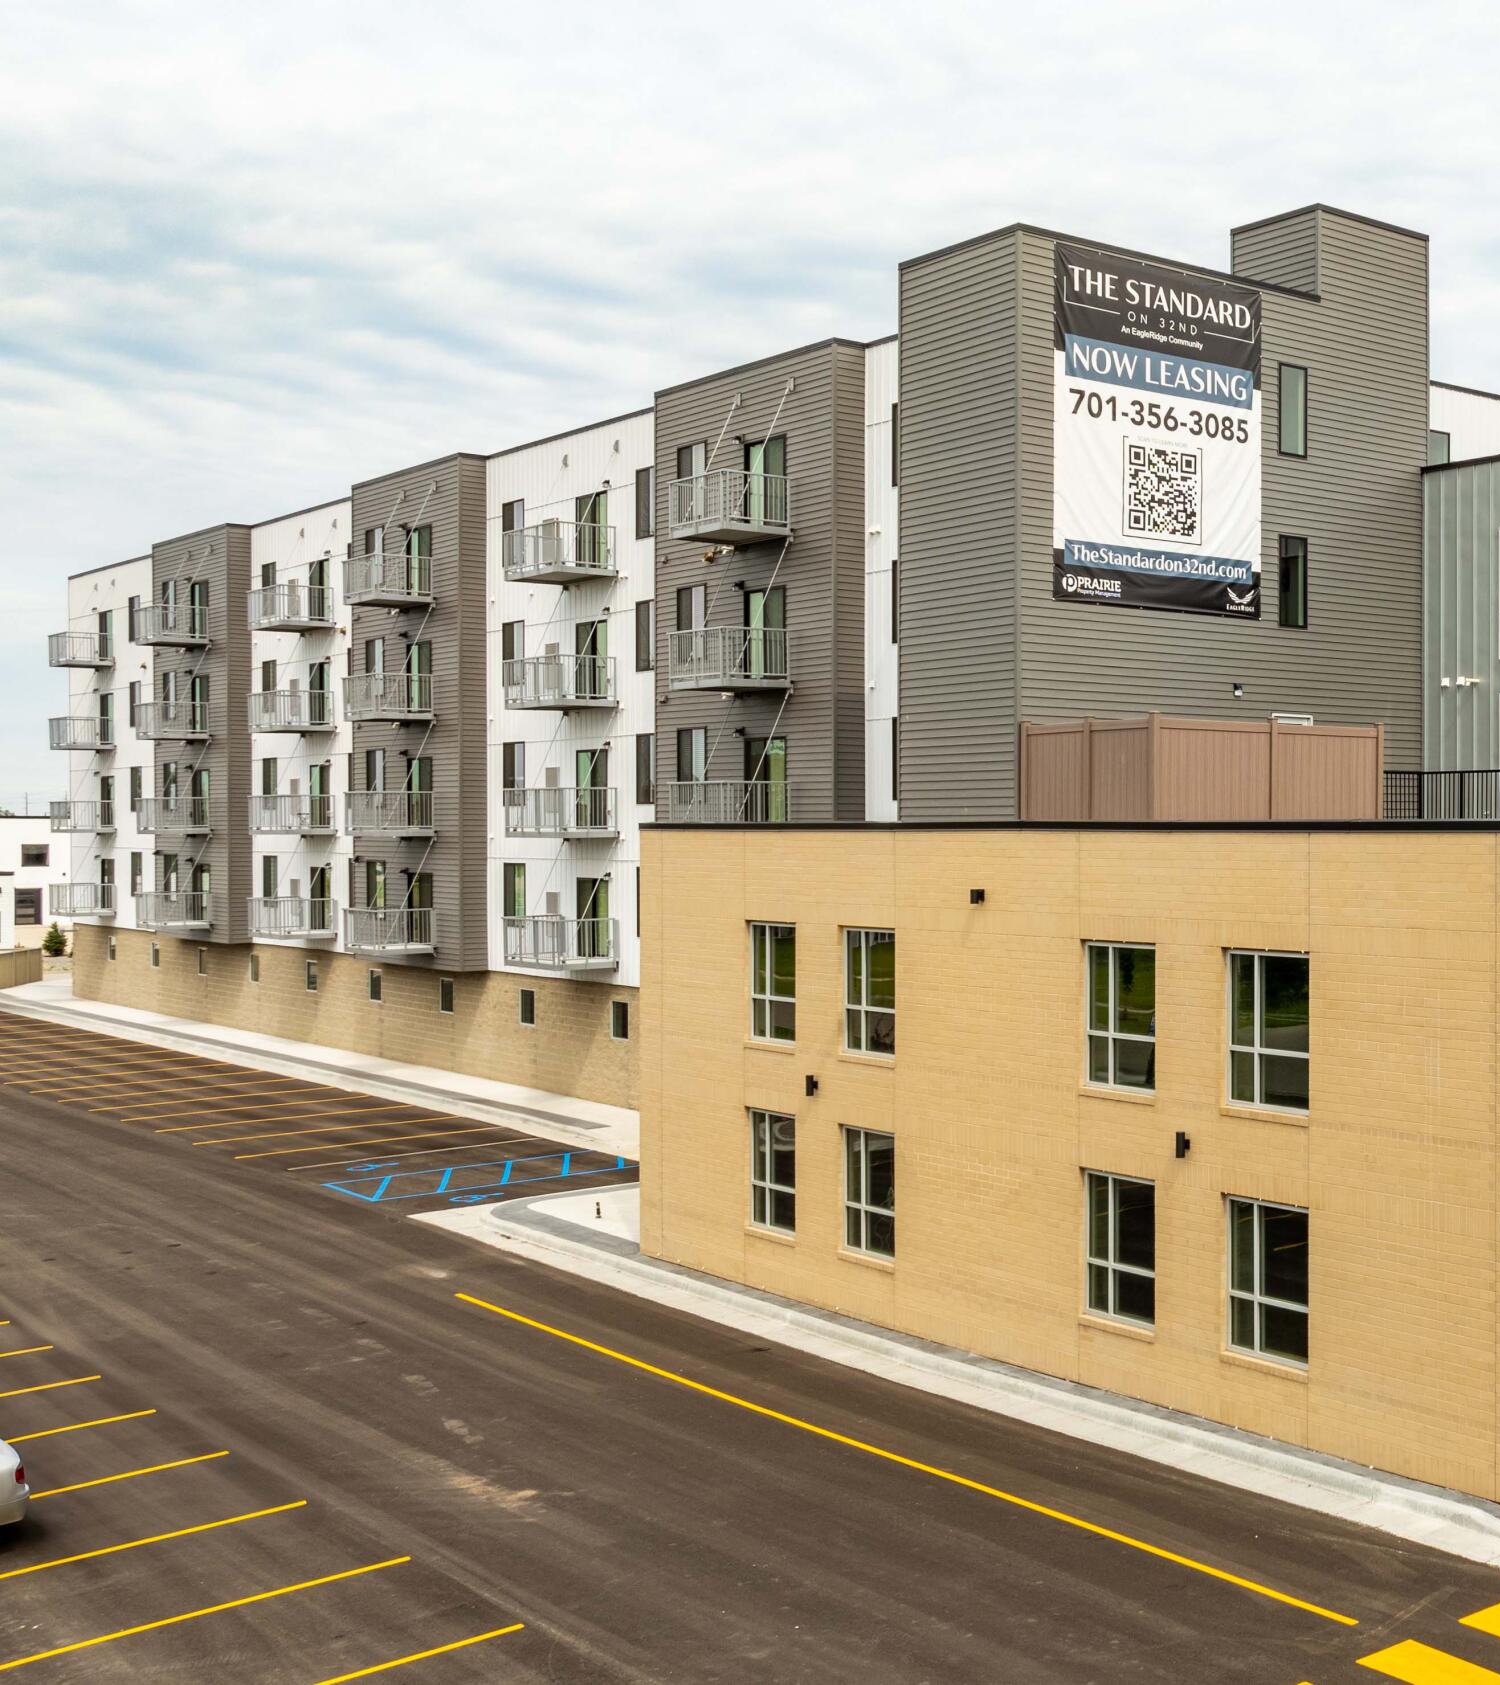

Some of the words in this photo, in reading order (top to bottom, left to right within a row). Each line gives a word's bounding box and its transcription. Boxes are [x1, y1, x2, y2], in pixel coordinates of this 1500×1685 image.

[1068, 264, 1119, 301] THE
[1125, 279, 1251, 329] STANDARD
[1121, 325, 1131, 334] An
[1131, 327, 1168, 343] EagleRidge
[1168, 335, 1204, 351] Community
[1127, 311, 1148, 325] ON
[1159, 317, 1198, 336] 32ND
[1073, 341, 1138, 380] NOW
[1145, 357, 1247, 401] LEASING
[1069, 387, 1249, 444] 701-356-3085
[1071, 544, 1247, 580] TheStandardon32nd.com
[1077, 576, 1122, 593] PRAIRIE
